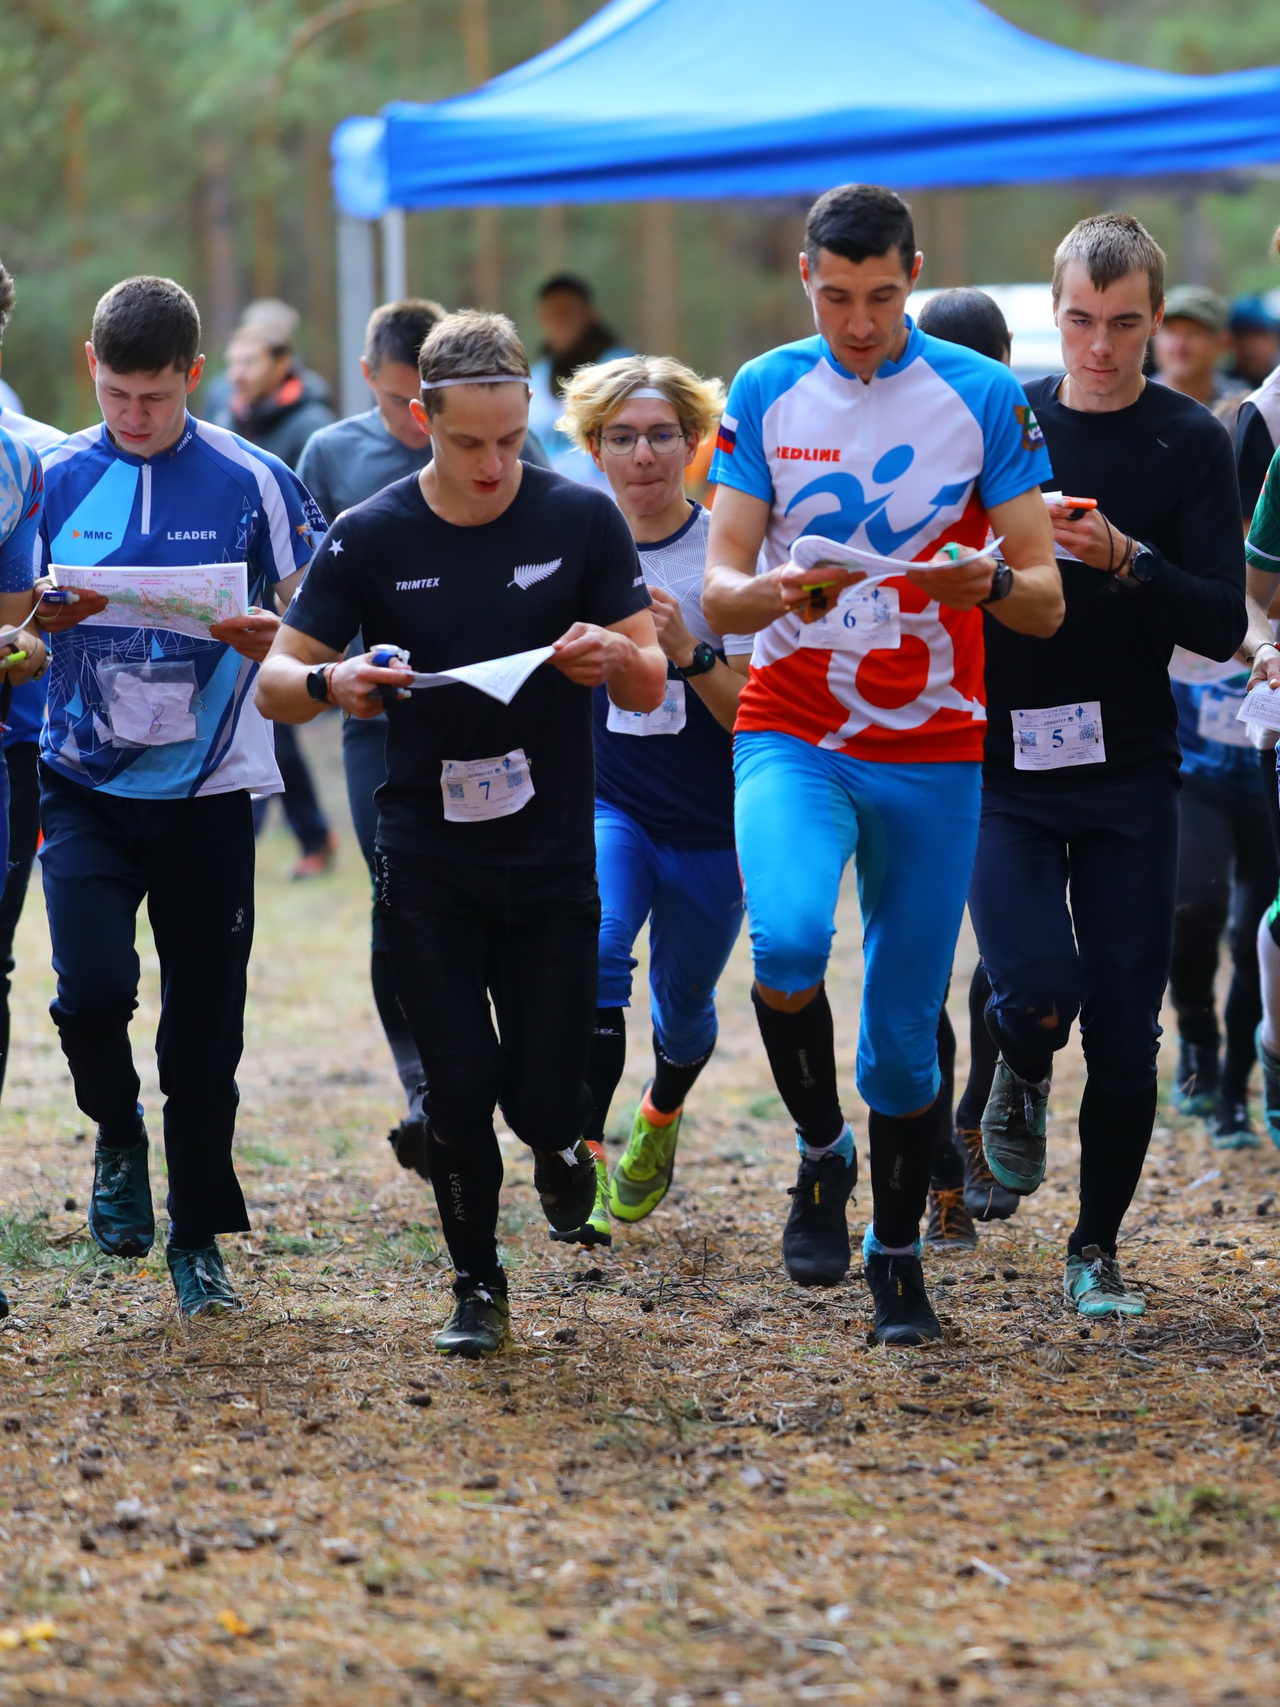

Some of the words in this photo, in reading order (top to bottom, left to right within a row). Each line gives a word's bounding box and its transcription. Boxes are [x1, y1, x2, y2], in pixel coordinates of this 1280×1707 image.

[83, 530, 113, 540] MMC
[167, 530, 217, 540] LEADER
[395, 576, 440, 591] TRIMTEX
[843, 608, 857, 629] 6
[150, 703, 164, 735] 8
[1052, 728, 1065, 749] 5
[478, 780, 491, 801] 7
